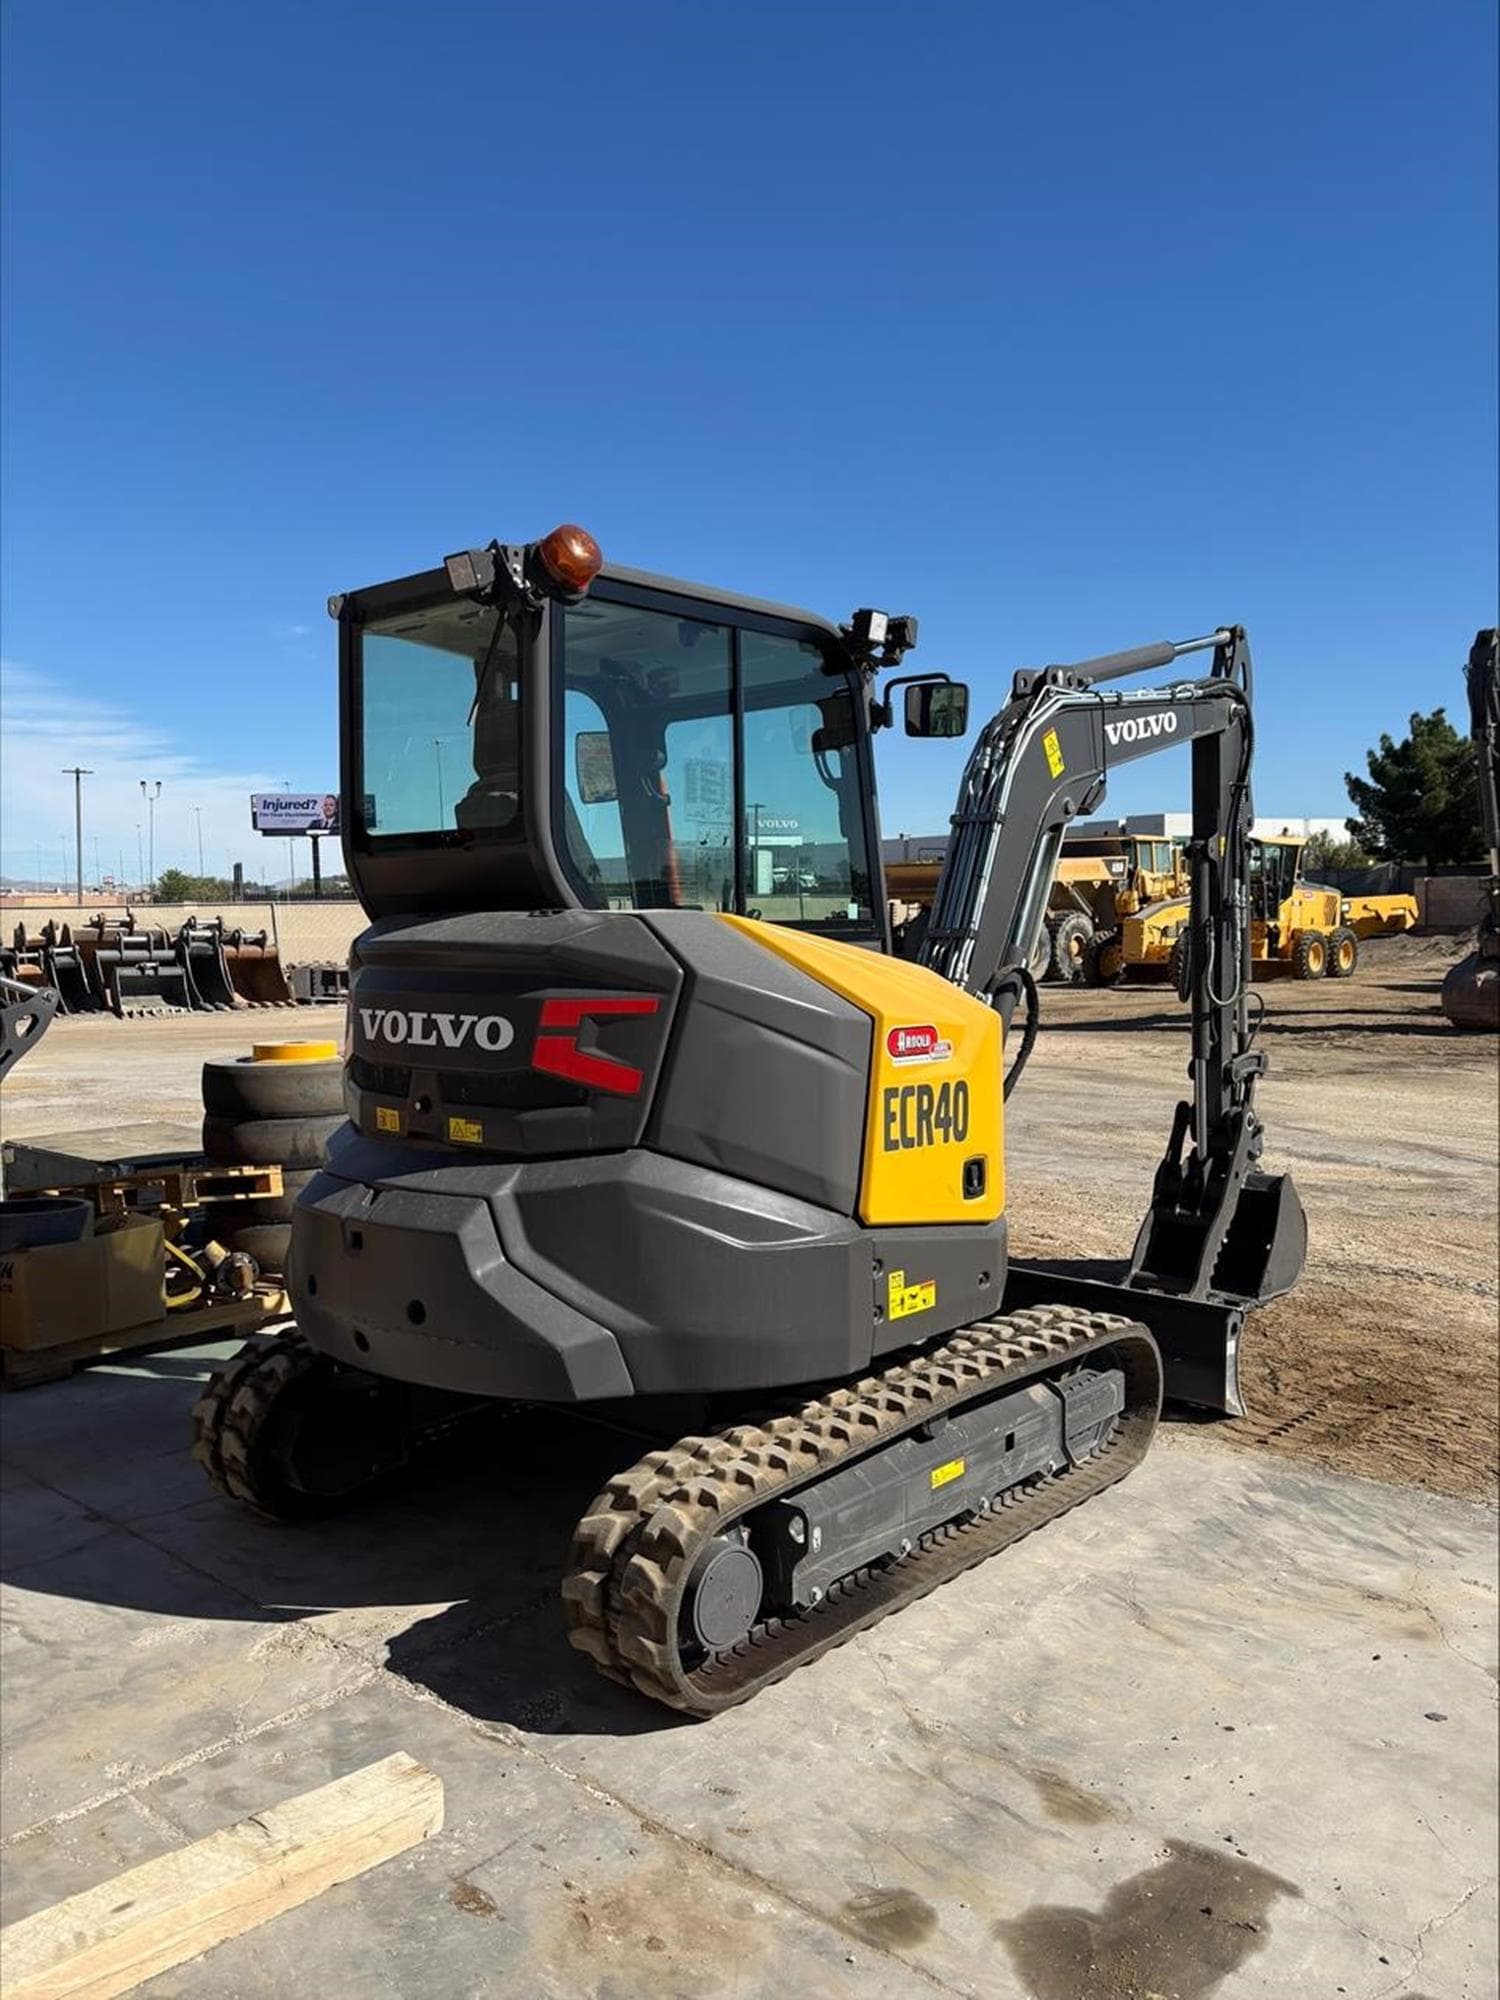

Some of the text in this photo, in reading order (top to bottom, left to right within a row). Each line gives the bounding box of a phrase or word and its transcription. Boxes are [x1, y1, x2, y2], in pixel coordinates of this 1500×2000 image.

[1104, 711, 1177, 745] VOLVO
[262, 798, 318, 812] Injured?
[758, 819, 798, 829] VOLVO
[359, 1008, 515, 1051] VOLVO
[883, 1080, 969, 1152] ECR40
